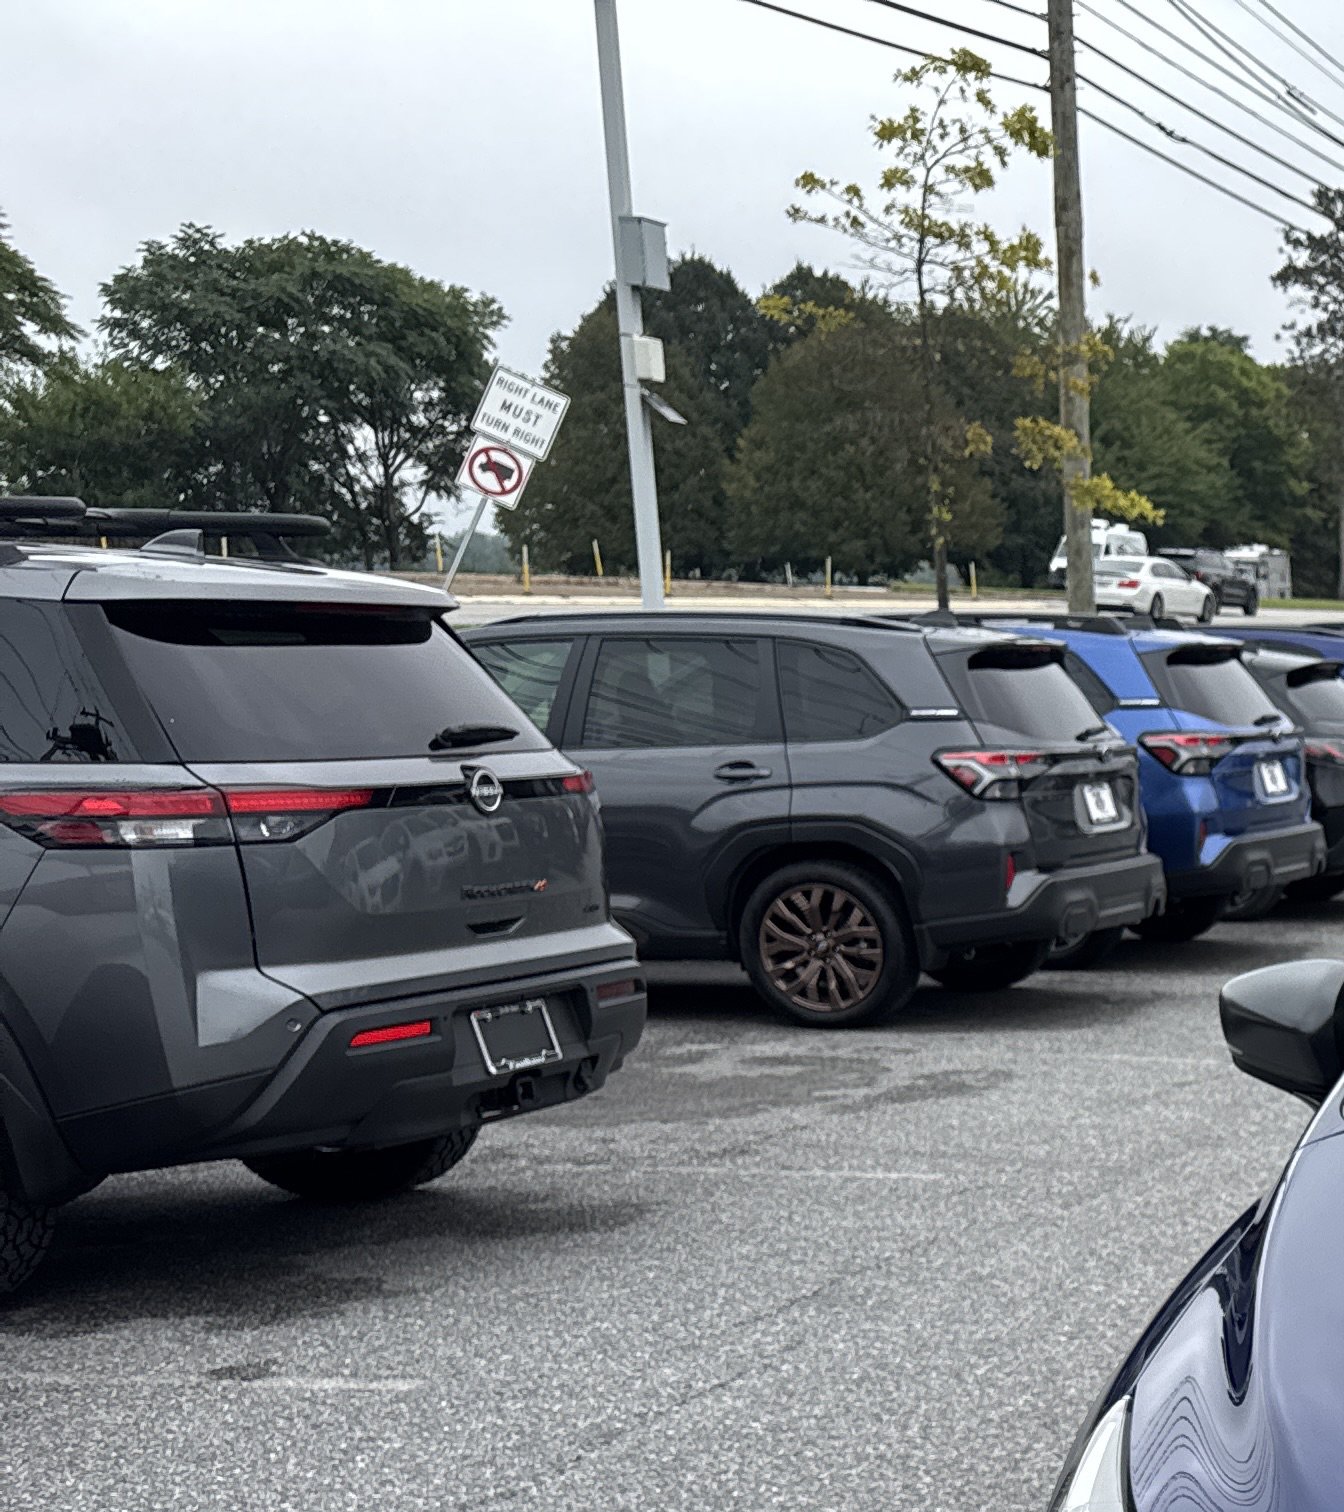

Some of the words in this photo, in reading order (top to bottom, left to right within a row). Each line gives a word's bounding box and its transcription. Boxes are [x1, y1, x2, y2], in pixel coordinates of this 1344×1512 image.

[495, 376, 530, 399] RIGHT
[531, 392, 562, 415] LANE
[500, 398, 543, 428] MUST
[480, 412, 511, 433] TURN
[512, 426, 547, 450] RIGHT
